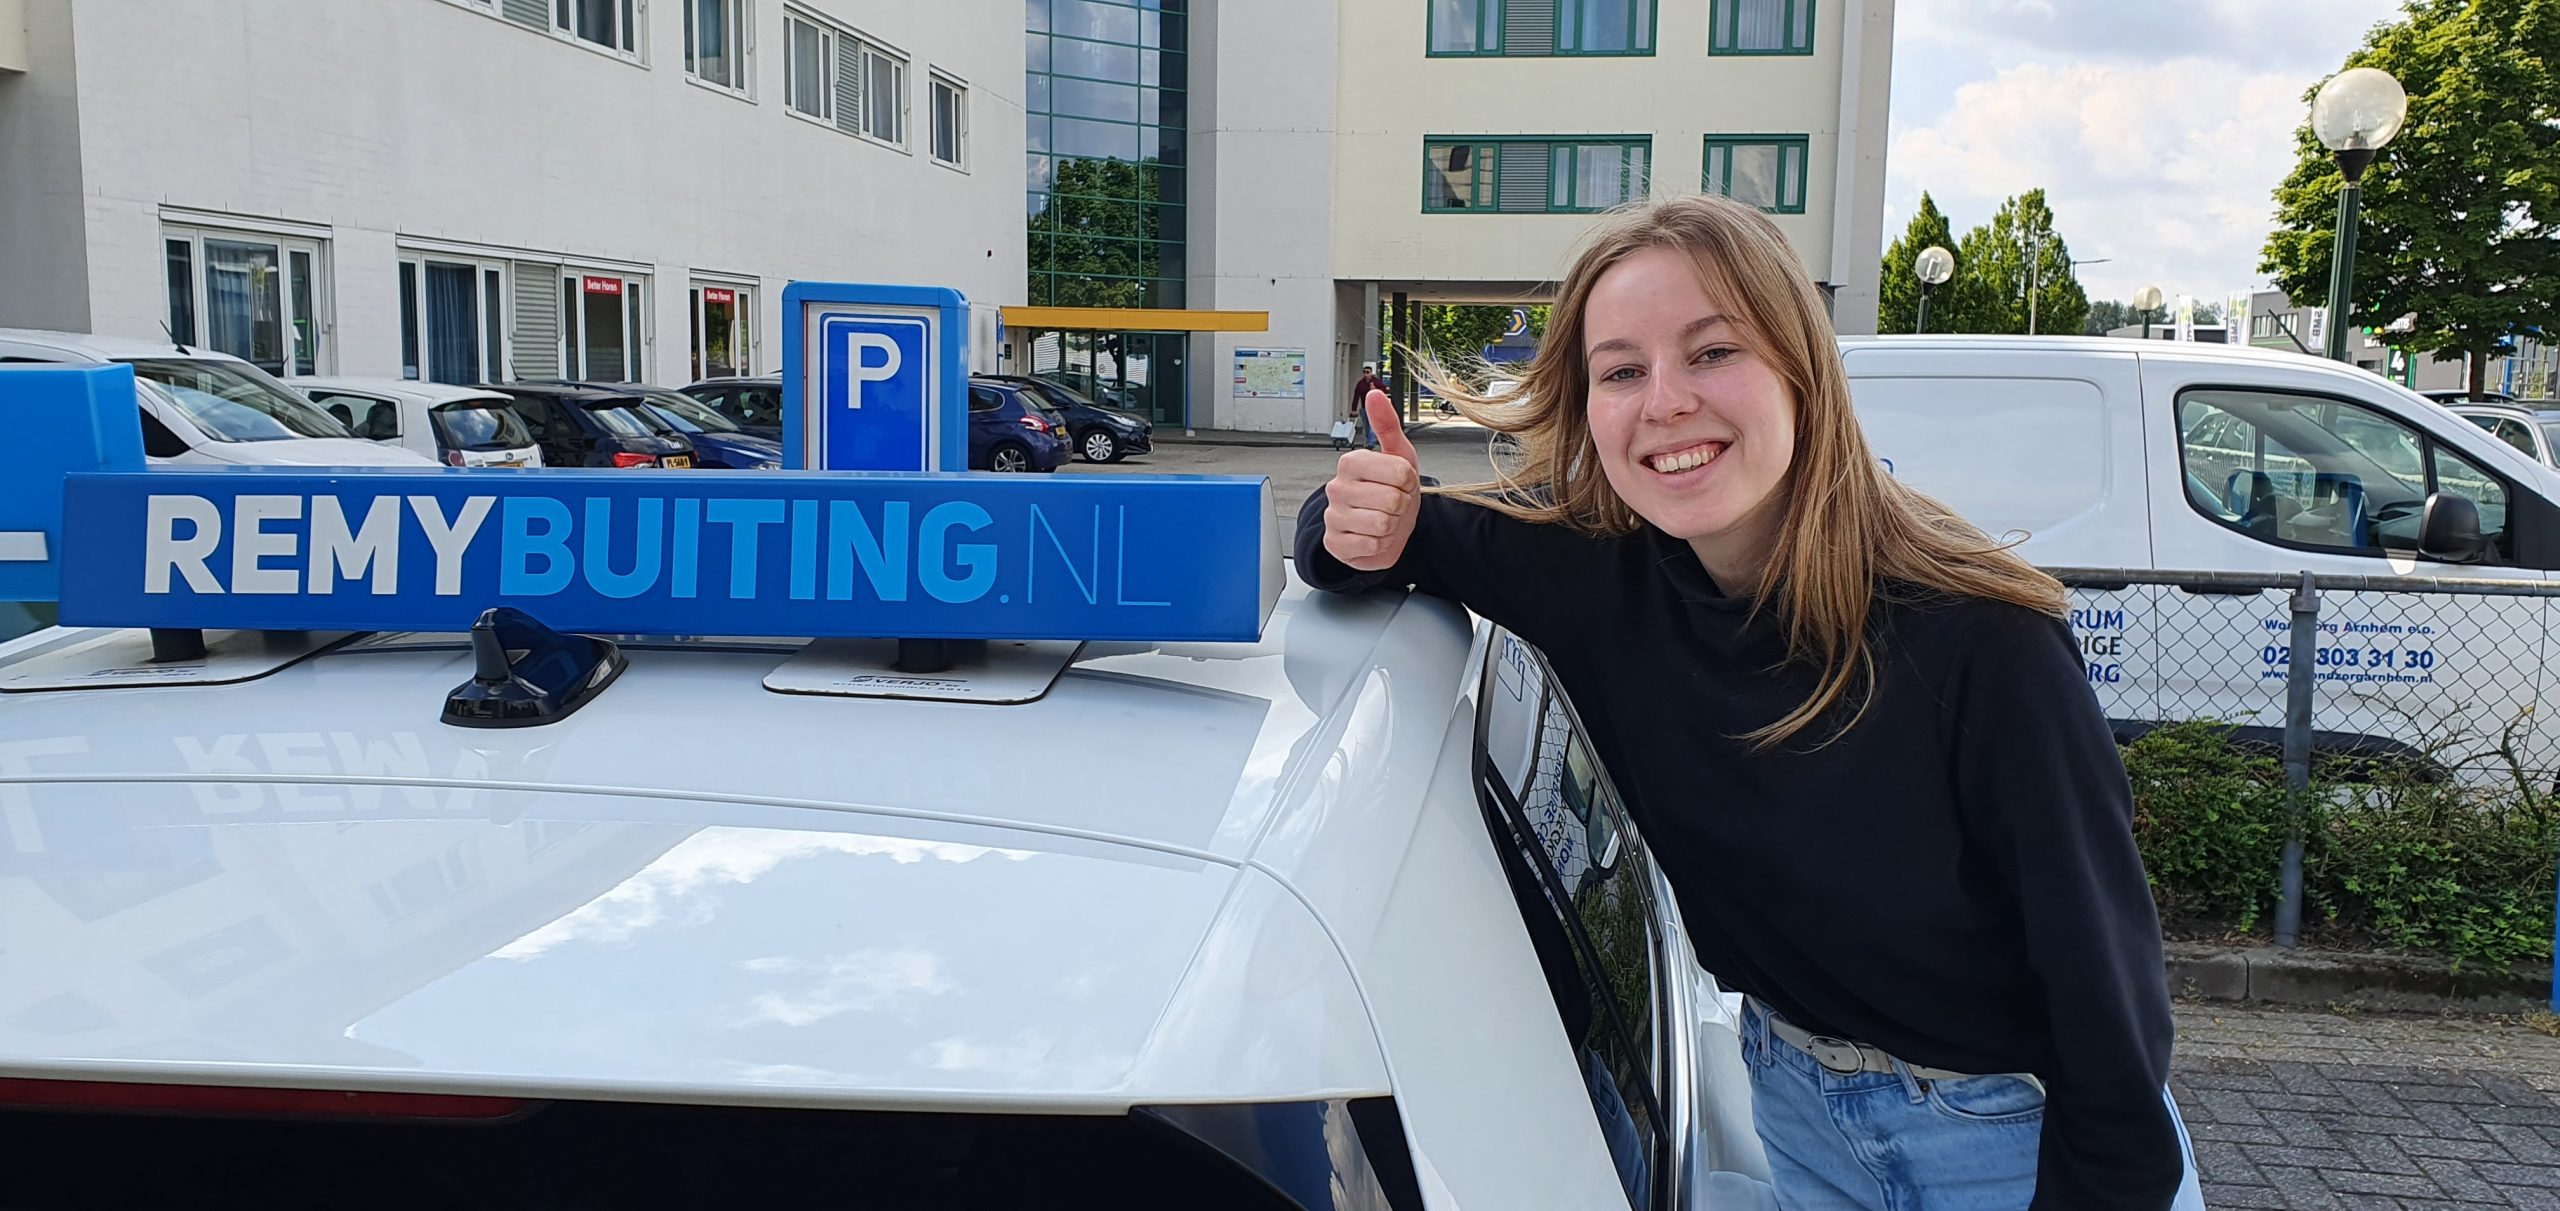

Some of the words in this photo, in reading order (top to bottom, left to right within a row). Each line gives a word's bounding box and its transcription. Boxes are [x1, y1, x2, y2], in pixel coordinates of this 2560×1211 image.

[847, 332, 902, 409] P
[144, 494, 1172, 606] REMYBUITING.NL
[2343, 621, 2402, 634] Arnhem
[2367, 648, 2394, 668] 31
[2404, 650, 2434, 669] 30
